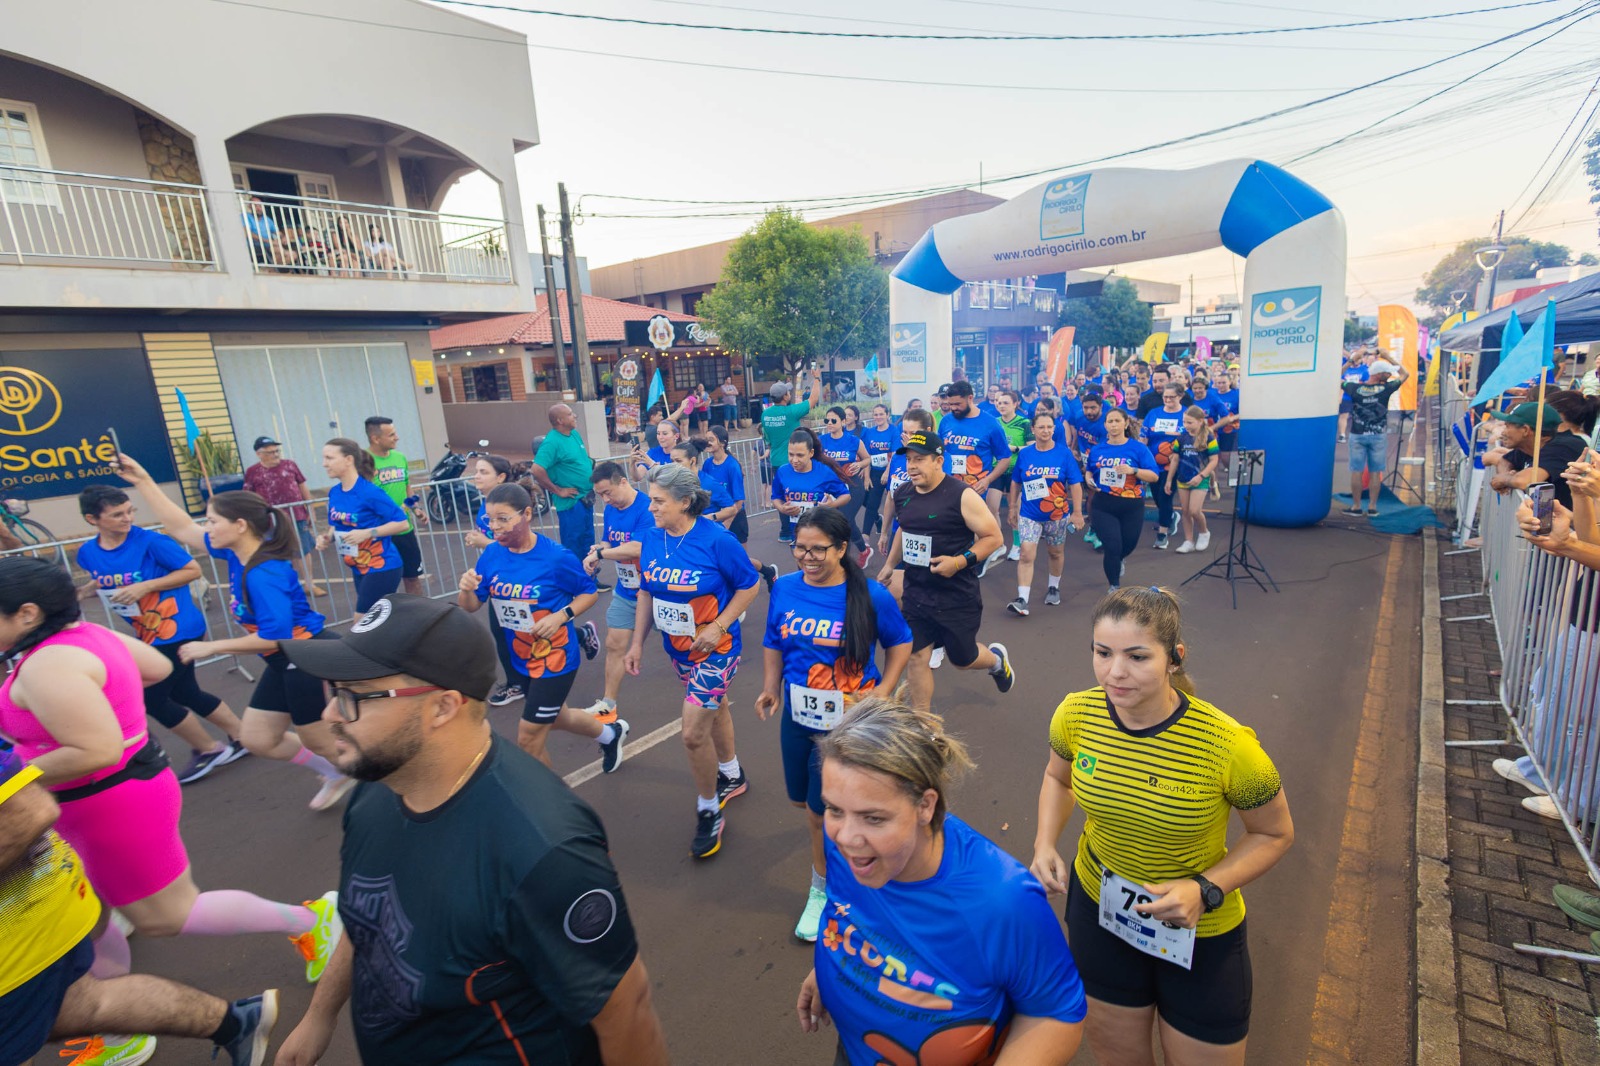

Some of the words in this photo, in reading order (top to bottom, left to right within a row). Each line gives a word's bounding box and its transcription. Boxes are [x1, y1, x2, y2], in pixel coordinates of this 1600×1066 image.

[1045, 198, 1077, 209] RODRIGO
[1059, 205, 1082, 214] CIRILO
[994, 230, 1147, 261] www.rodrigocirilo.com.br
[1254, 326, 1306, 338] RODRIGO
[1276, 334, 1315, 345] CIRILO
[871, 441, 892, 450] CORES
[949, 434, 980, 447] CORES
[0, 435, 116, 471] Santê
[827, 449, 850, 460] CORES
[1032, 466, 1061, 476] CORES
[788, 491, 819, 502] CORES
[905, 539, 919, 551] 283
[651, 567, 702, 585] CORES
[494, 582, 541, 599] CORES
[502, 606, 516, 618] 25
[657, 605, 679, 621] 529
[789, 617, 846, 639] CORE
[802, 695, 818, 710] 13
